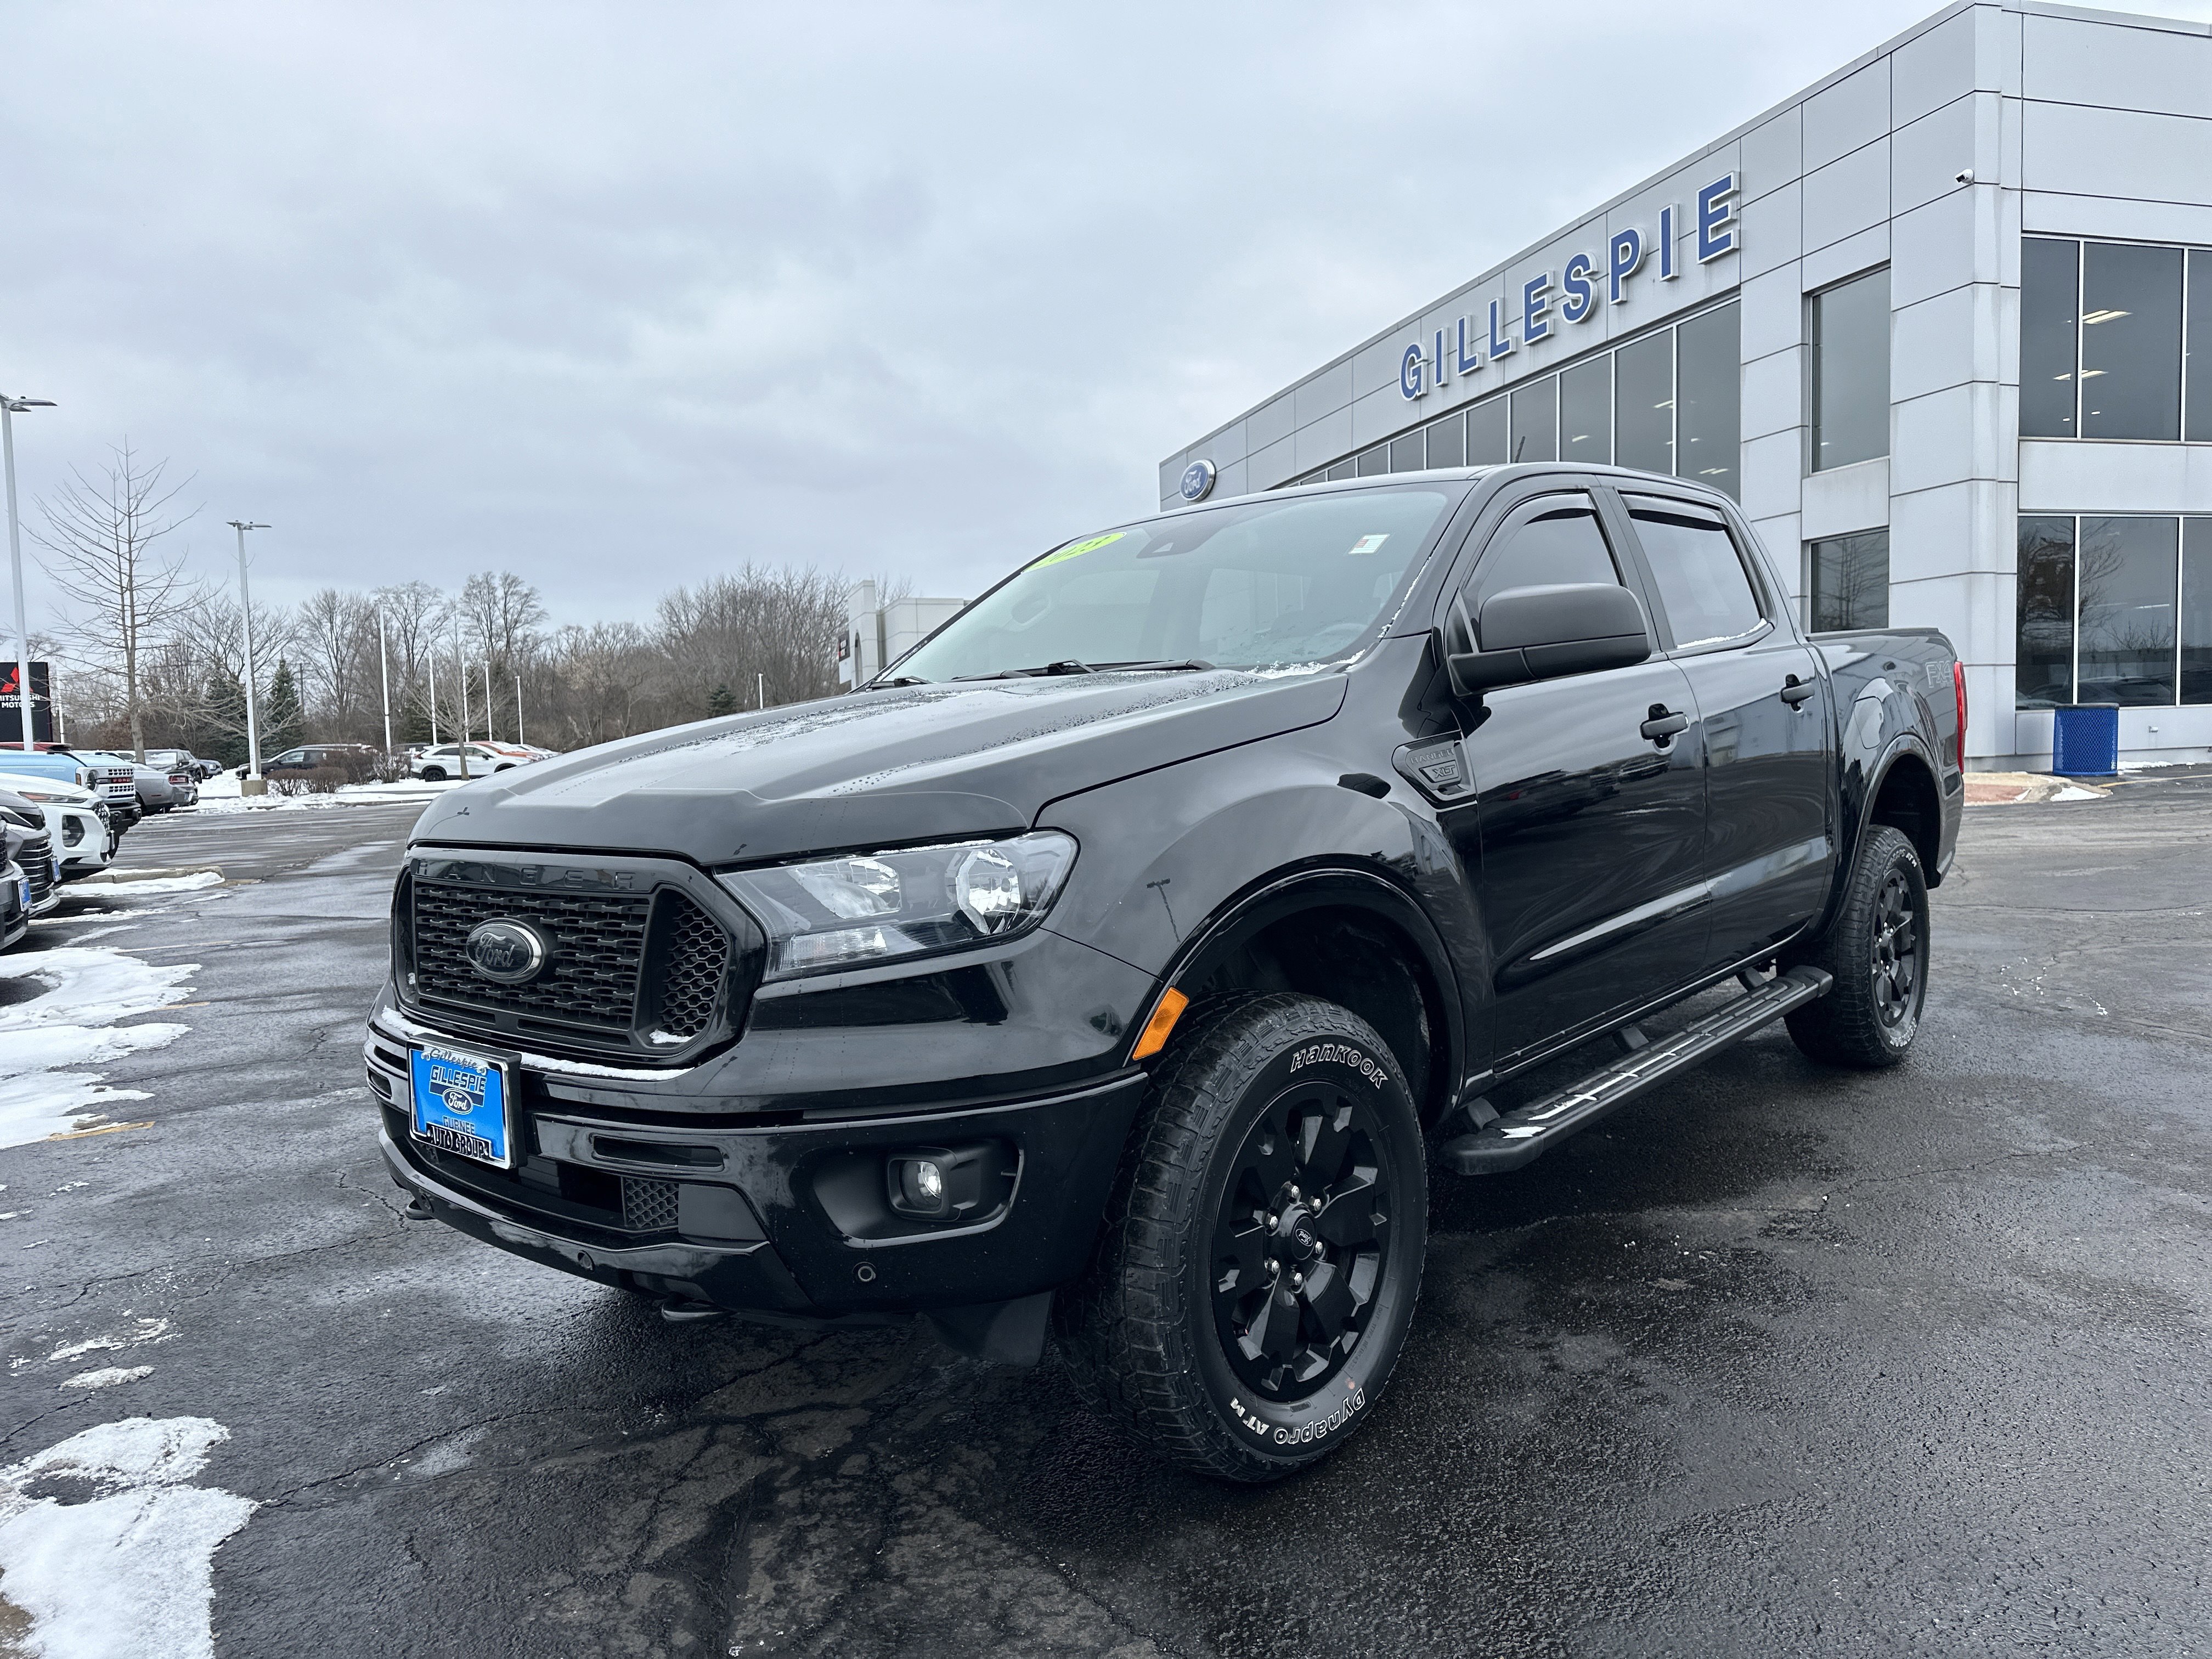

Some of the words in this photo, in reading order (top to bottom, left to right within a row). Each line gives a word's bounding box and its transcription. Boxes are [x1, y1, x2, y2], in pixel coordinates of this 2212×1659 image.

[1399, 171, 1740, 400] GILLESPIE
[1183, 469, 1201, 494] Ford
[1925, 661, 1953, 688] FX4
[1409, 748, 1454, 764] RANGER
[1432, 765, 1455, 779] XLT
[475, 932, 515, 968] Ford
[430, 1048, 477, 1069] Gillespie
[430, 1065, 487, 1094] GILLESPIE
[448, 1092, 467, 1110] Ford
[443, 1115, 476, 1135] GURNEE
[431, 1125, 454, 1150] AUTO
[455, 1133, 484, 1158] GROUP
[1298, 1231, 1311, 1245] Ford
[1273, 1387, 1365, 1445] Dynapro
